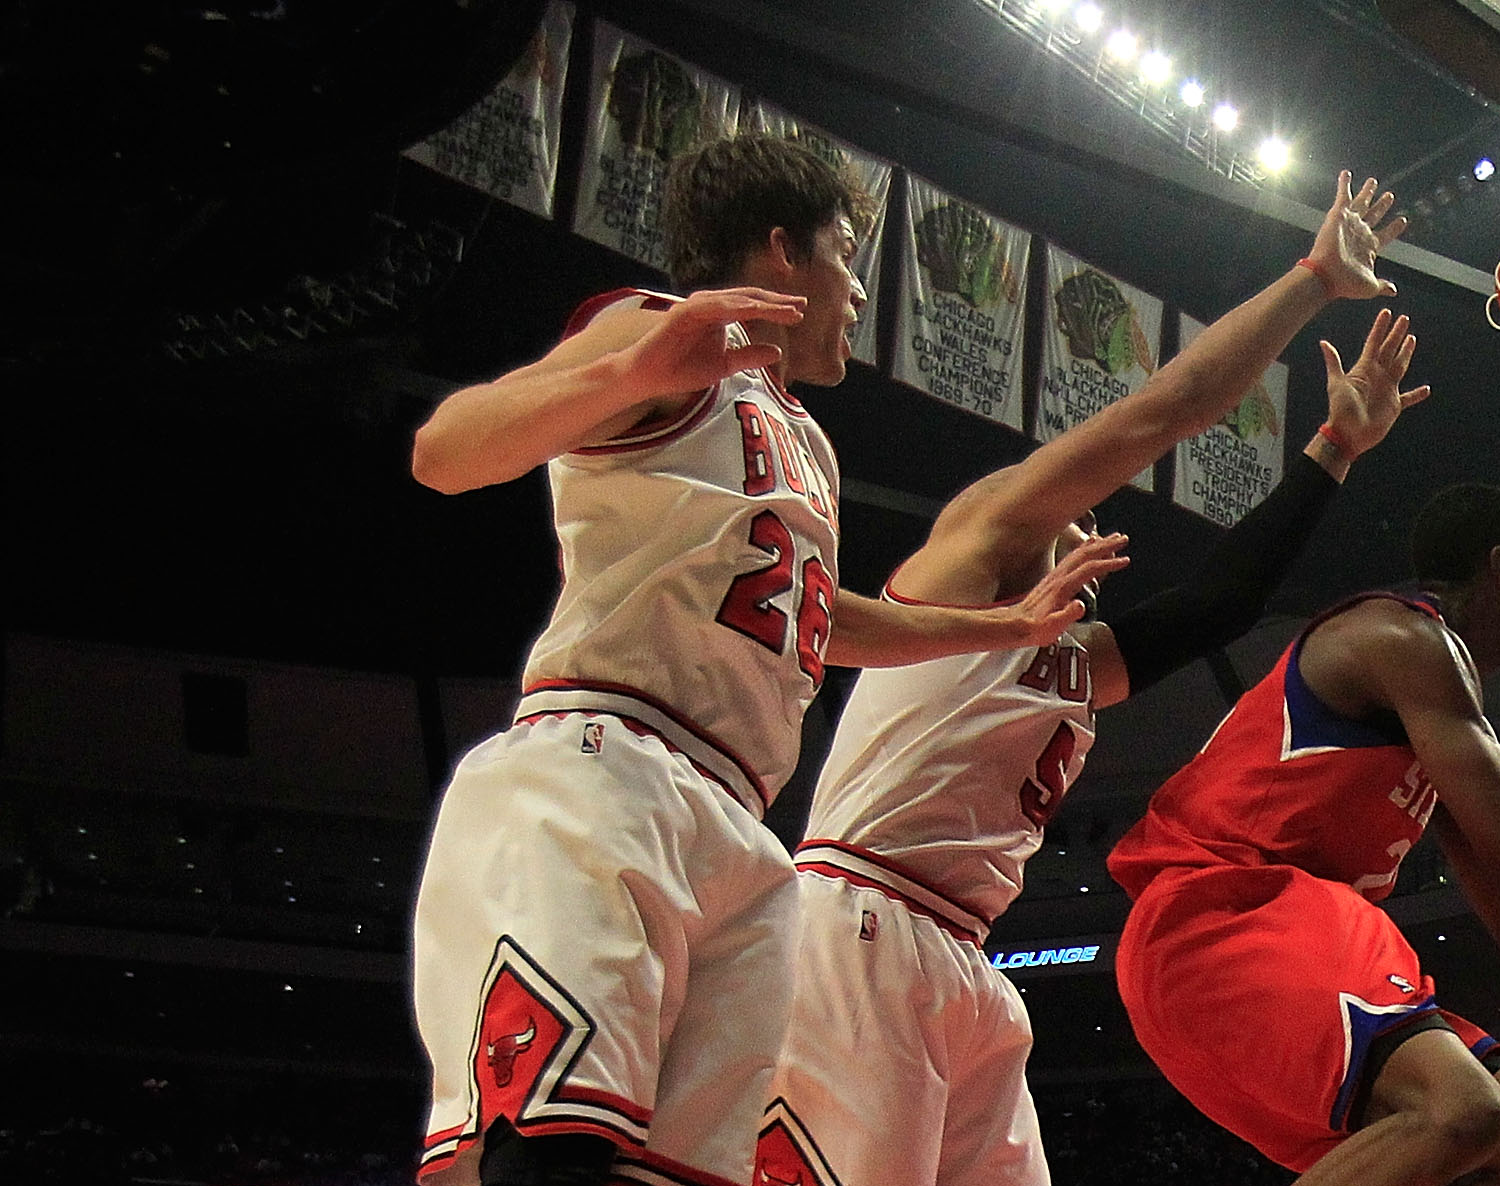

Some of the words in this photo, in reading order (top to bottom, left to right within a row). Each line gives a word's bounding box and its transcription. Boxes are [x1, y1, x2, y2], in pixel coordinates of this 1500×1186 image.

[913, 299, 1012, 357] BLACKHAWKS
[933, 292, 995, 333] CHICAGO
[912, 335, 1010, 389] CONFERENCE
[941, 329, 988, 363] WALES
[919, 354, 1003, 403] CHAMPIONS
[1071, 359, 1129, 398] CHICAGO
[1204, 427, 1258, 461] CHICAGO
[1203, 469, 1254, 504] TROPHY
[992, 946, 1100, 970] LOUNGE
